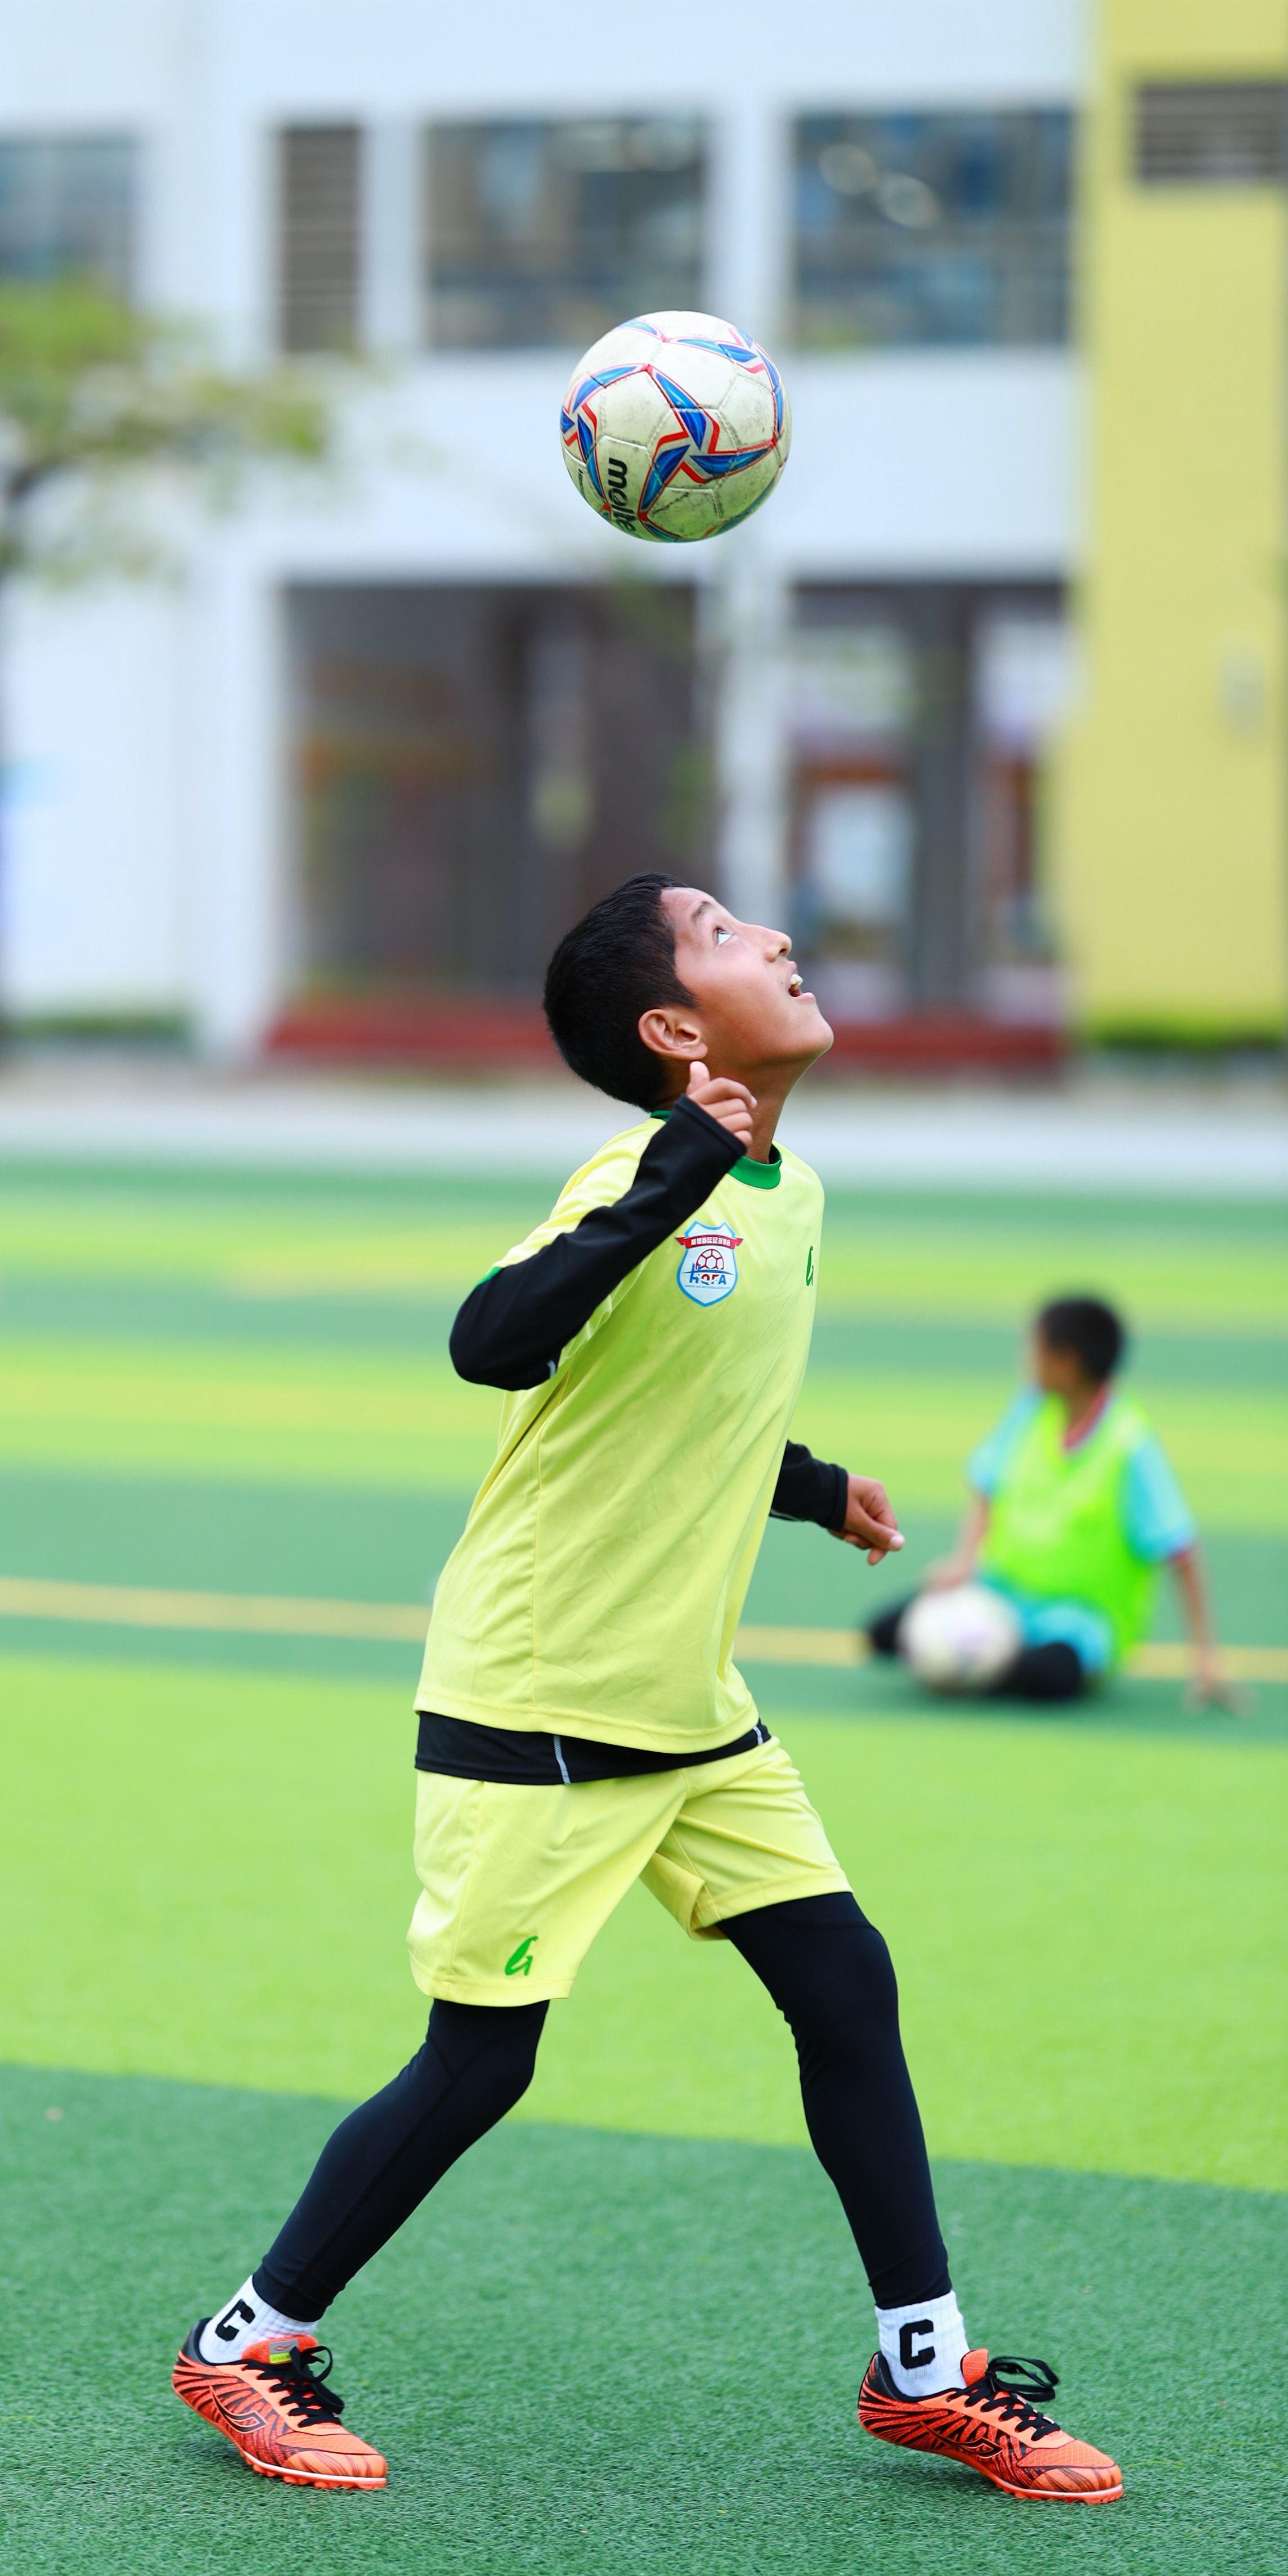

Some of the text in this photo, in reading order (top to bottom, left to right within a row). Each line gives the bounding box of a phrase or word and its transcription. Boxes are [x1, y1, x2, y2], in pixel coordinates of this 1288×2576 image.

[689, 1263, 727, 1285] HQFA
[215, 2299, 255, 2342] C
[899, 2319, 935, 2369] C
